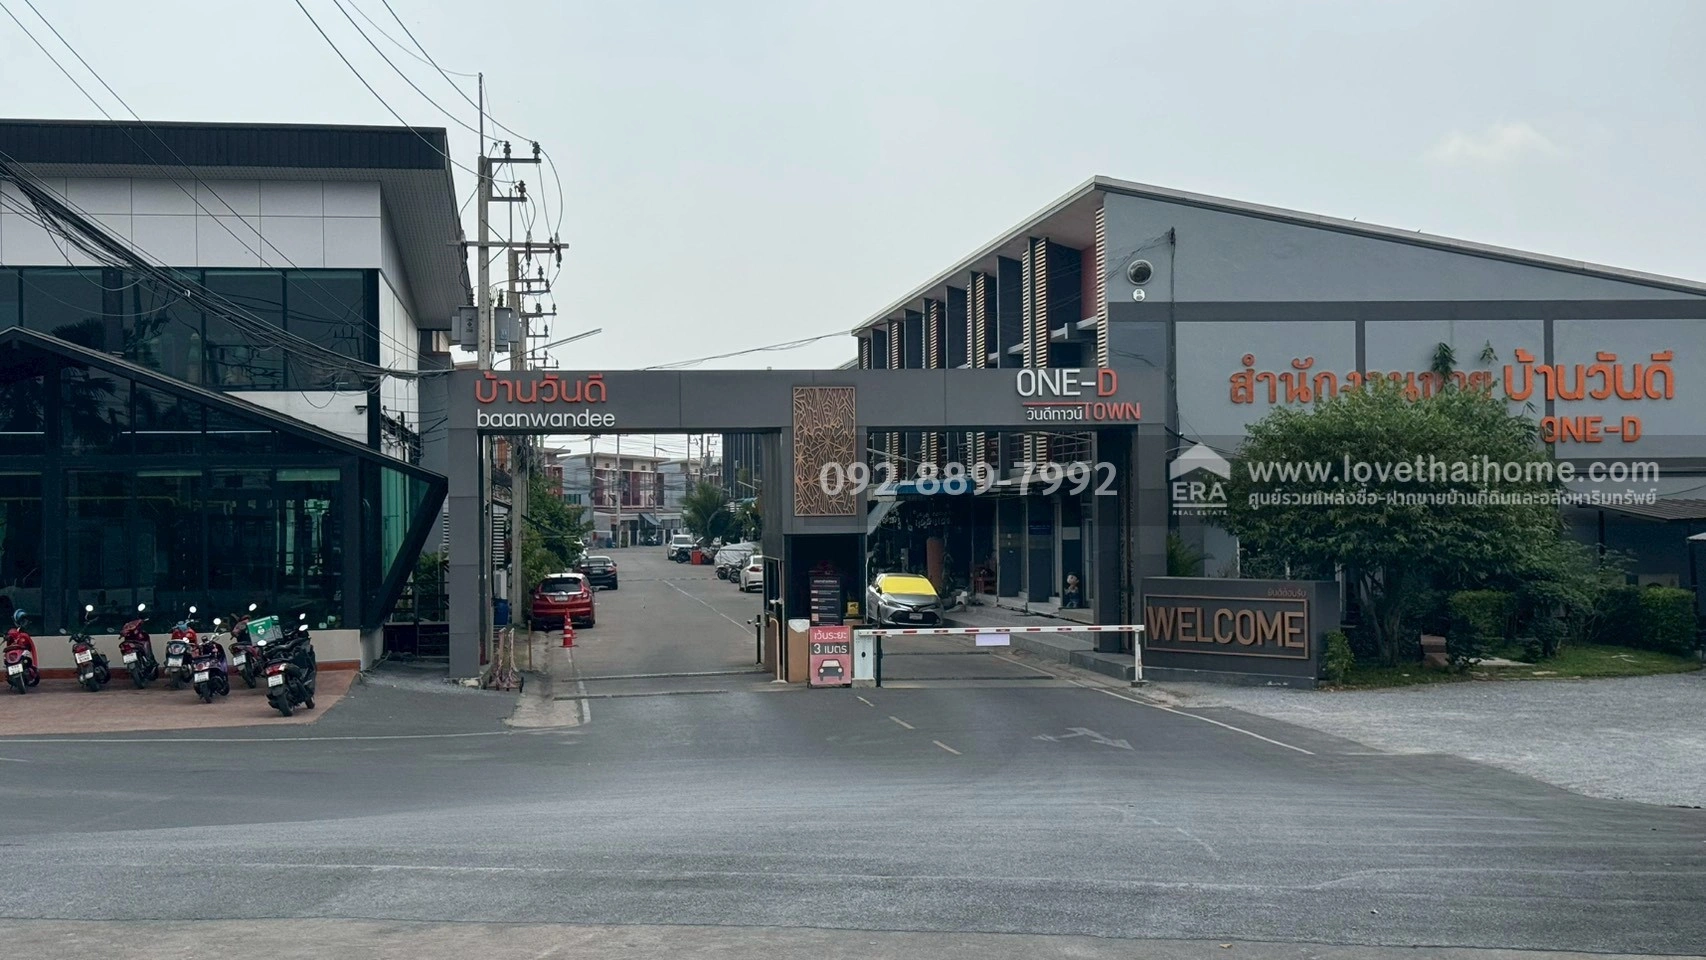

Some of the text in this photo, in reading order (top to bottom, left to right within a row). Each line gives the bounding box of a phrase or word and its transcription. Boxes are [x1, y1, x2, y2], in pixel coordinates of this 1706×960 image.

[474, 371, 607, 404] บ้านวันดี
[1016, 368, 1119, 397] ONE-D
[1503, 348, 1675, 401] บ้านวันดี
[476, 408, 616, 428] baanwandee
[1026, 402, 1142, 421] วันดีทาวน์ TOWN
[1540, 415, 1643, 443] ONE-D
[814, 629, 847, 640] เว้นระยะ
[1147, 606, 1305, 648] WELCOME
[813, 643, 848, 654] 3 เมตร
